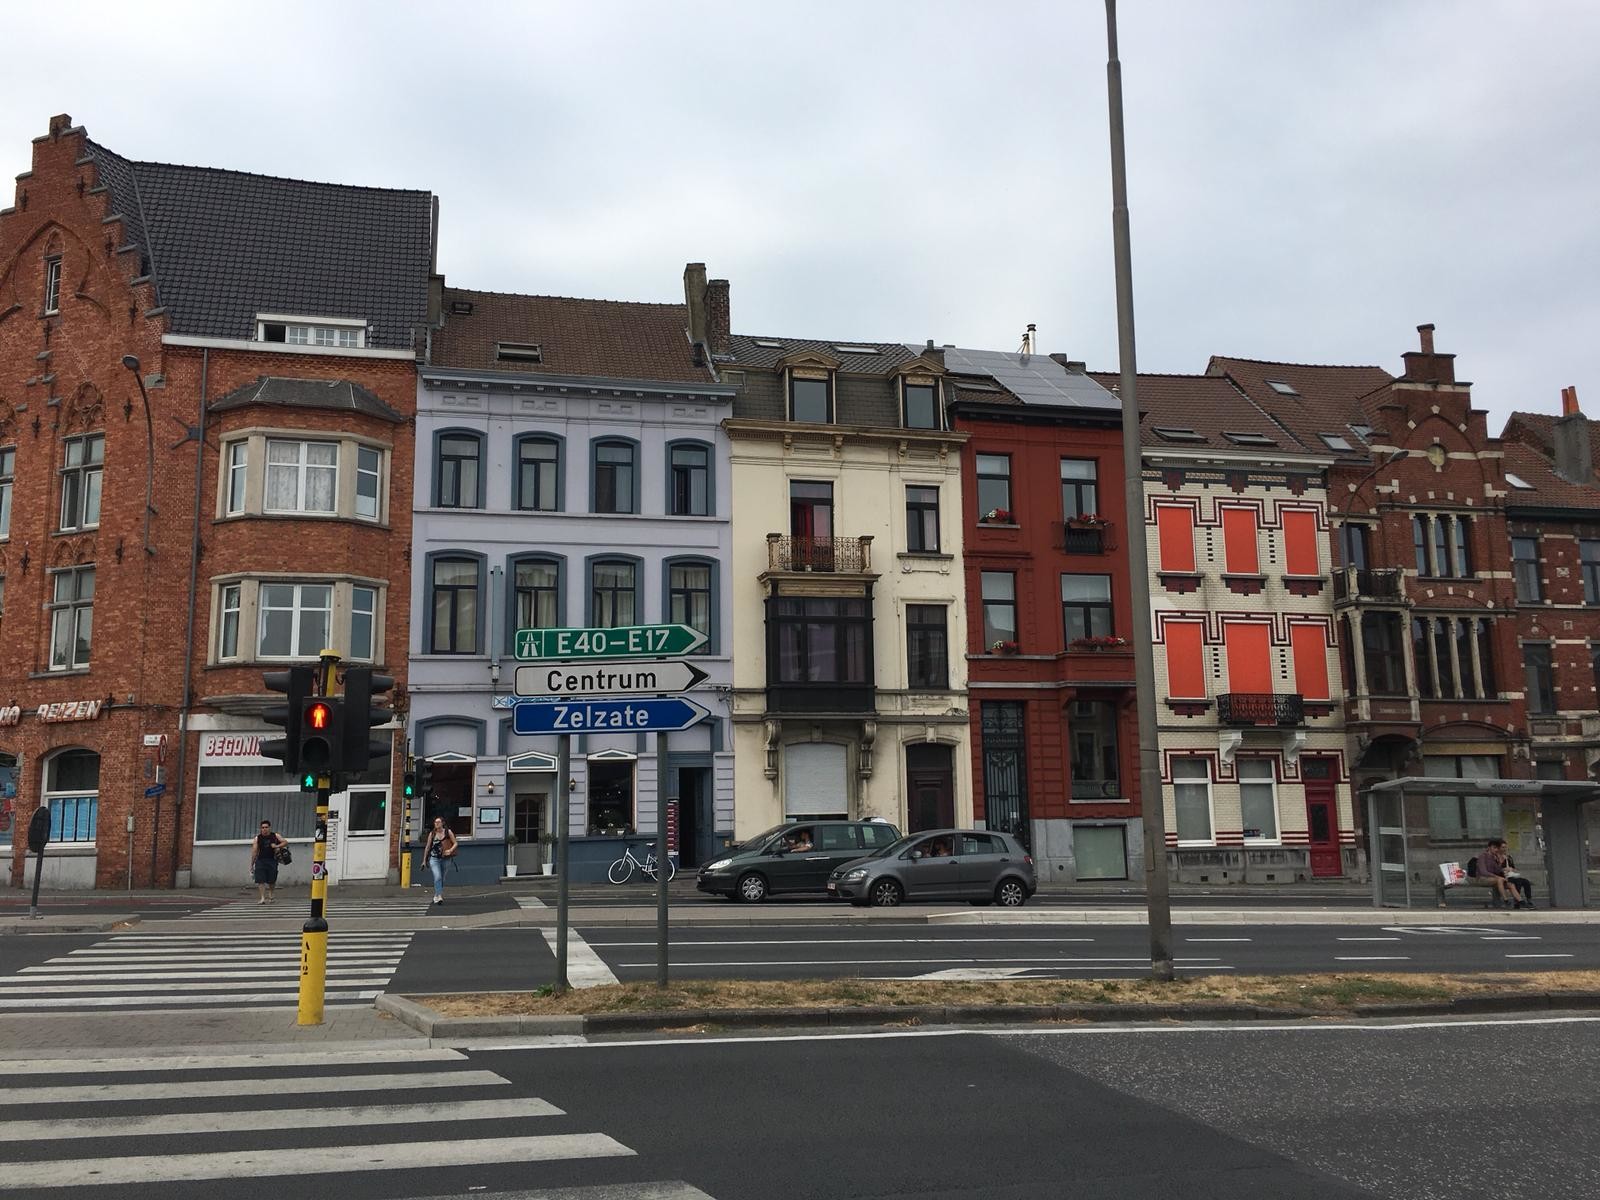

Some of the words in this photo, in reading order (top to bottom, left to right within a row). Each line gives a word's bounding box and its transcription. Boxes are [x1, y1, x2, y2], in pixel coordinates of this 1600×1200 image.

[547, 669, 657, 692] Centrum
[35, 699, 102, 723] REIZEN
[553, 705, 649, 729] Zelzate
